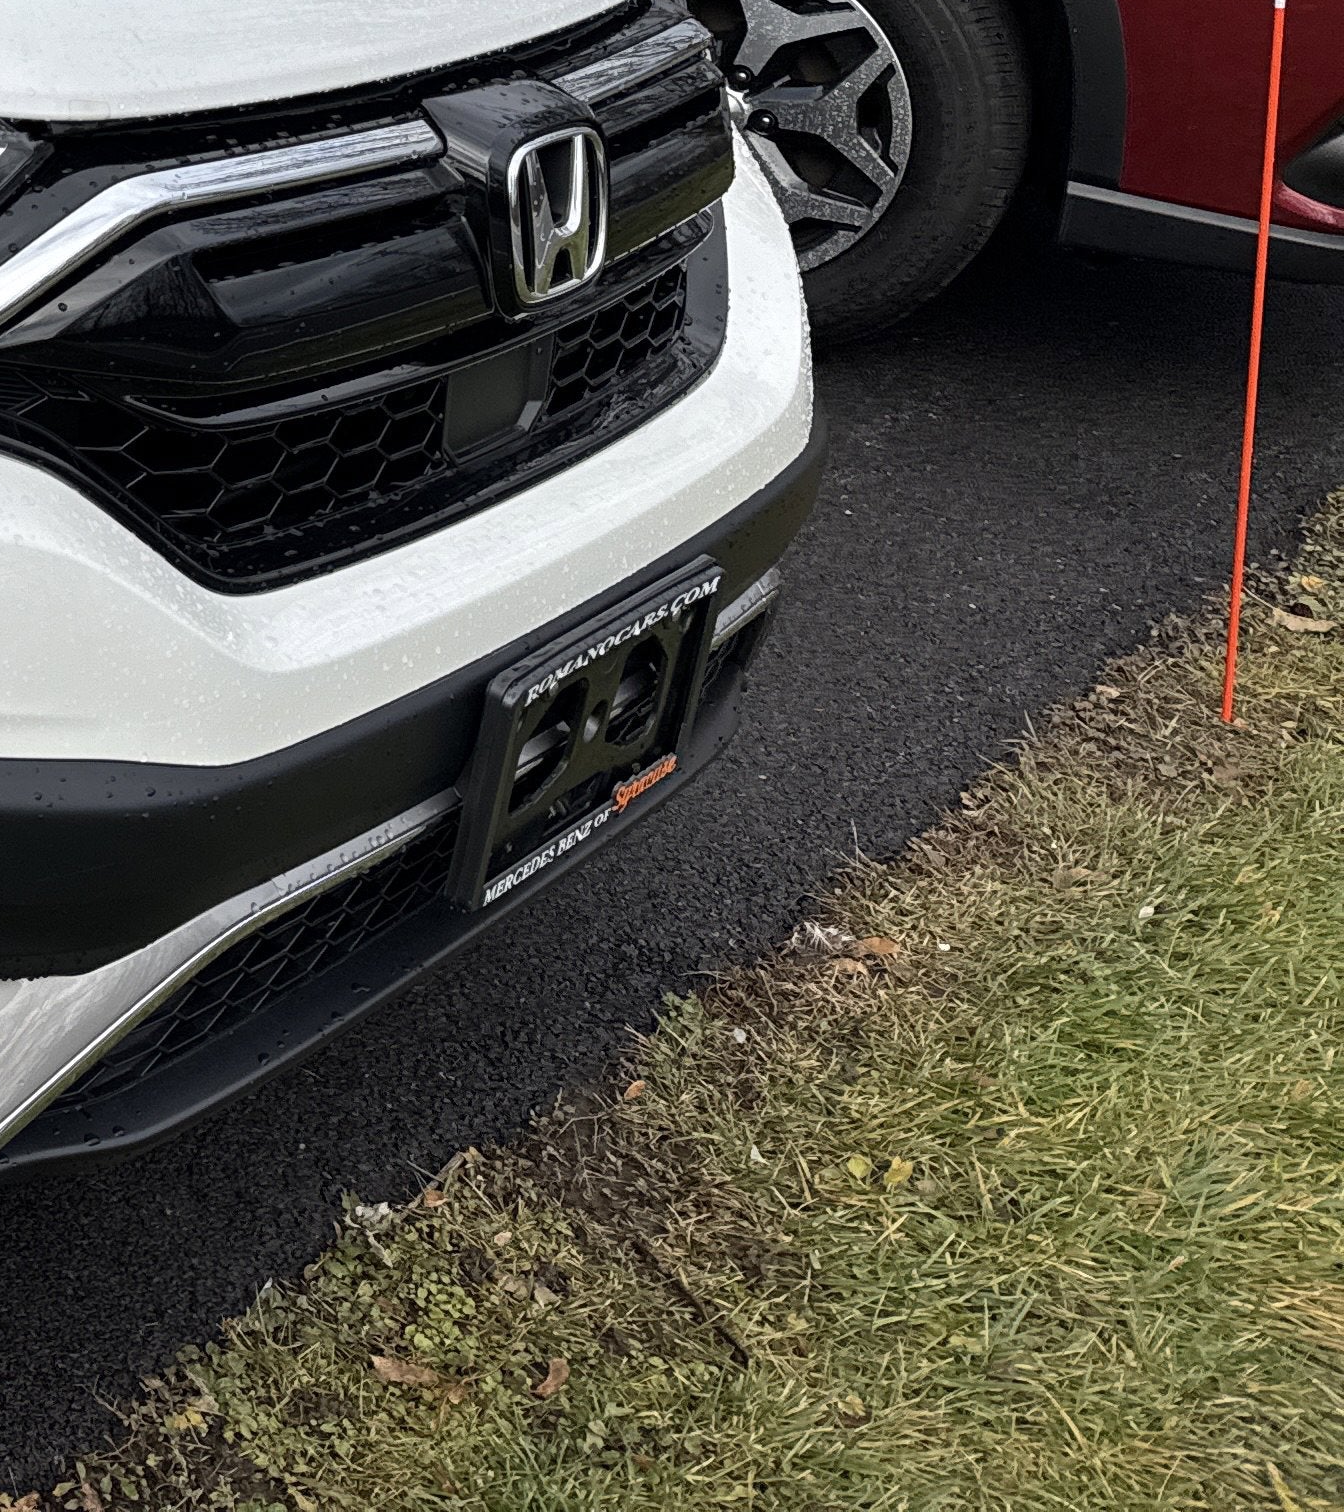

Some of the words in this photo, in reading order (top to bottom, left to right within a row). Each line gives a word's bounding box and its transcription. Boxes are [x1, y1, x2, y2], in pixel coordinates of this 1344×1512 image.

[525, 575, 721, 707] ROMANOCARS.COM
[483, 844, 556, 907] MERCEDES
[556, 820, 594, 858] BENZ
[593, 807, 613, 832] OF
